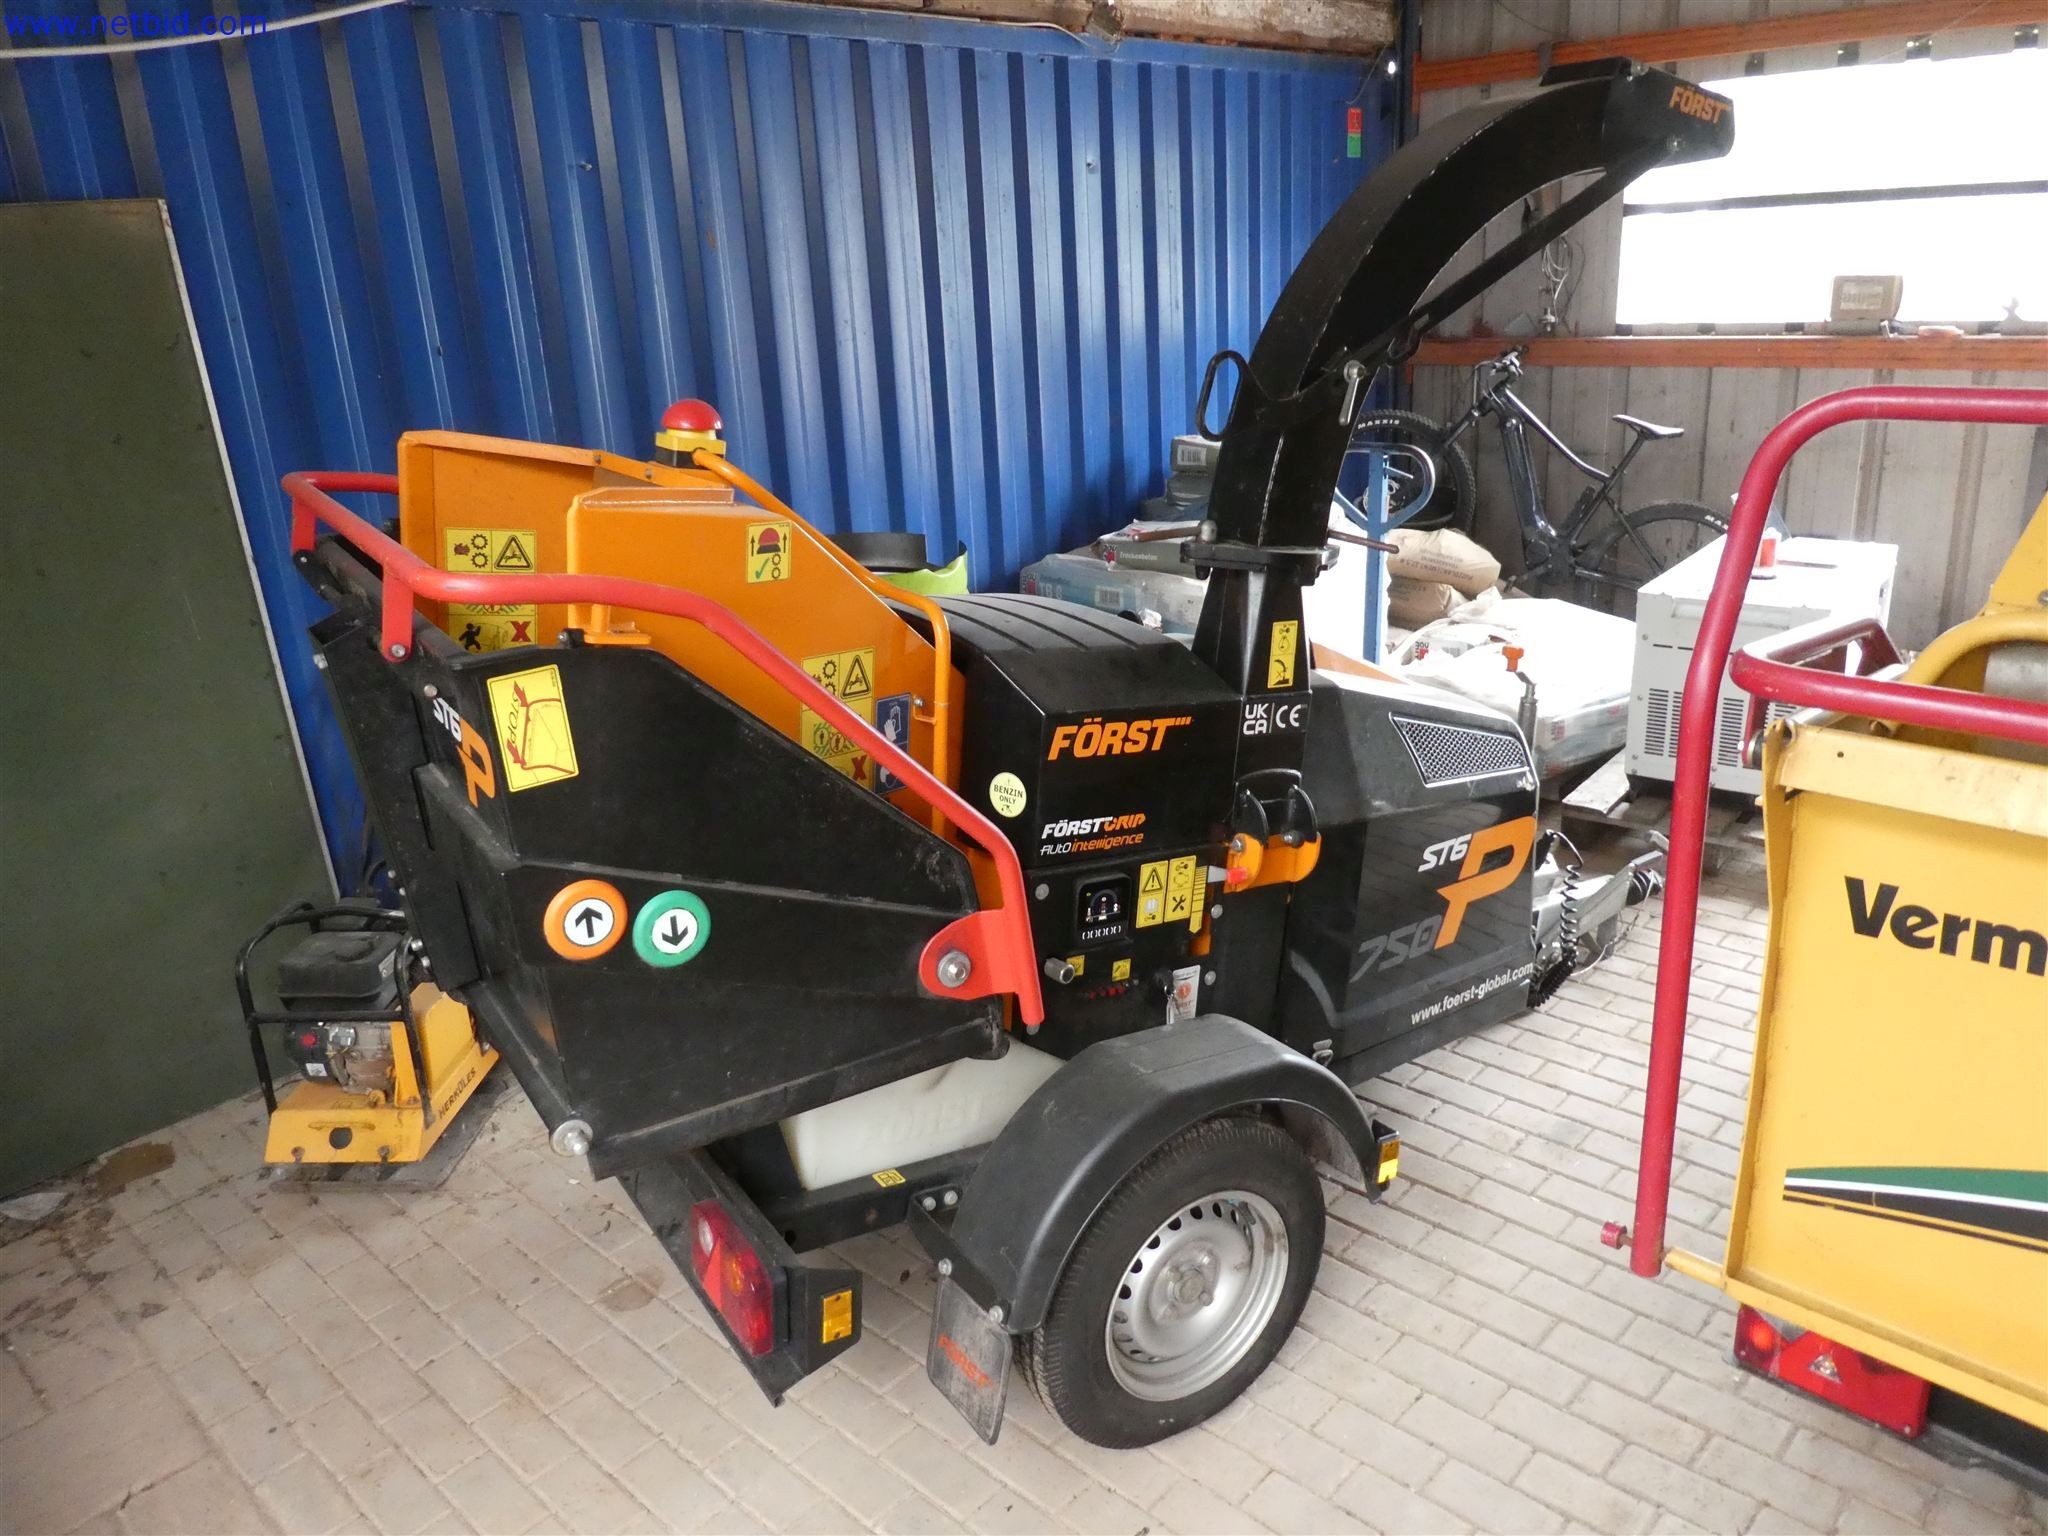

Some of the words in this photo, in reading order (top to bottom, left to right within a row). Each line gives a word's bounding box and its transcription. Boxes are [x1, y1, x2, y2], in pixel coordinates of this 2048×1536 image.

[1245, 703, 1269, 719] UK
[1275, 704, 1301, 729] CE
[1243, 719, 1267, 735] CA
[1048, 717, 1191, 761] FÖRST
[993, 784, 1023, 798] BENZIN
[999, 794, 1016, 805] ONLY
[1071, 832, 1144, 854] intelligence
[1844, 875, 2048, 977] Verm
[1411, 962, 1534, 1025] www.foerst-global.com
